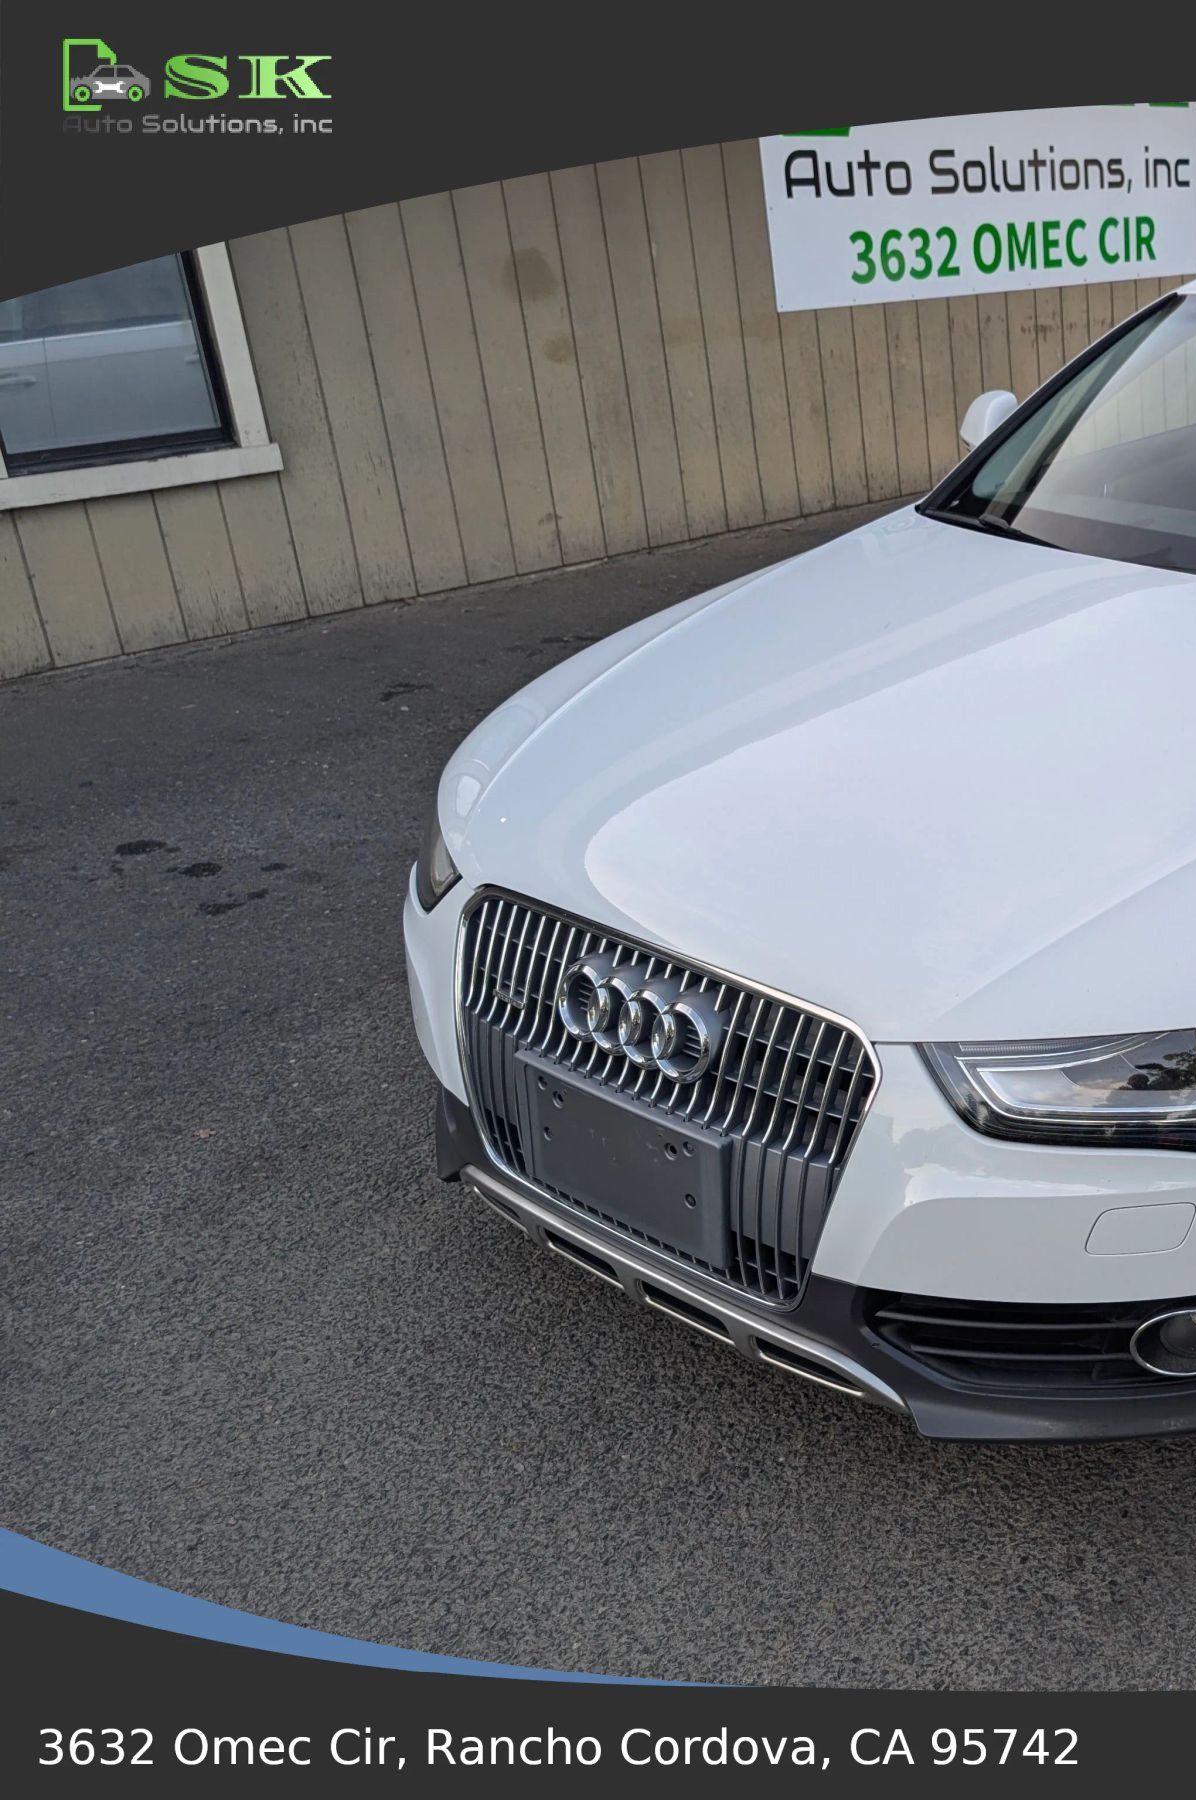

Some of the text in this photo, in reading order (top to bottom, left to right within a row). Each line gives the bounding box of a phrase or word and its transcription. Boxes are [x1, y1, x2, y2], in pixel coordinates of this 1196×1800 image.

[784, 145, 1191, 199] Auto Solutions, inc
[849, 215, 1157, 285] 3632 OMEC CIR
